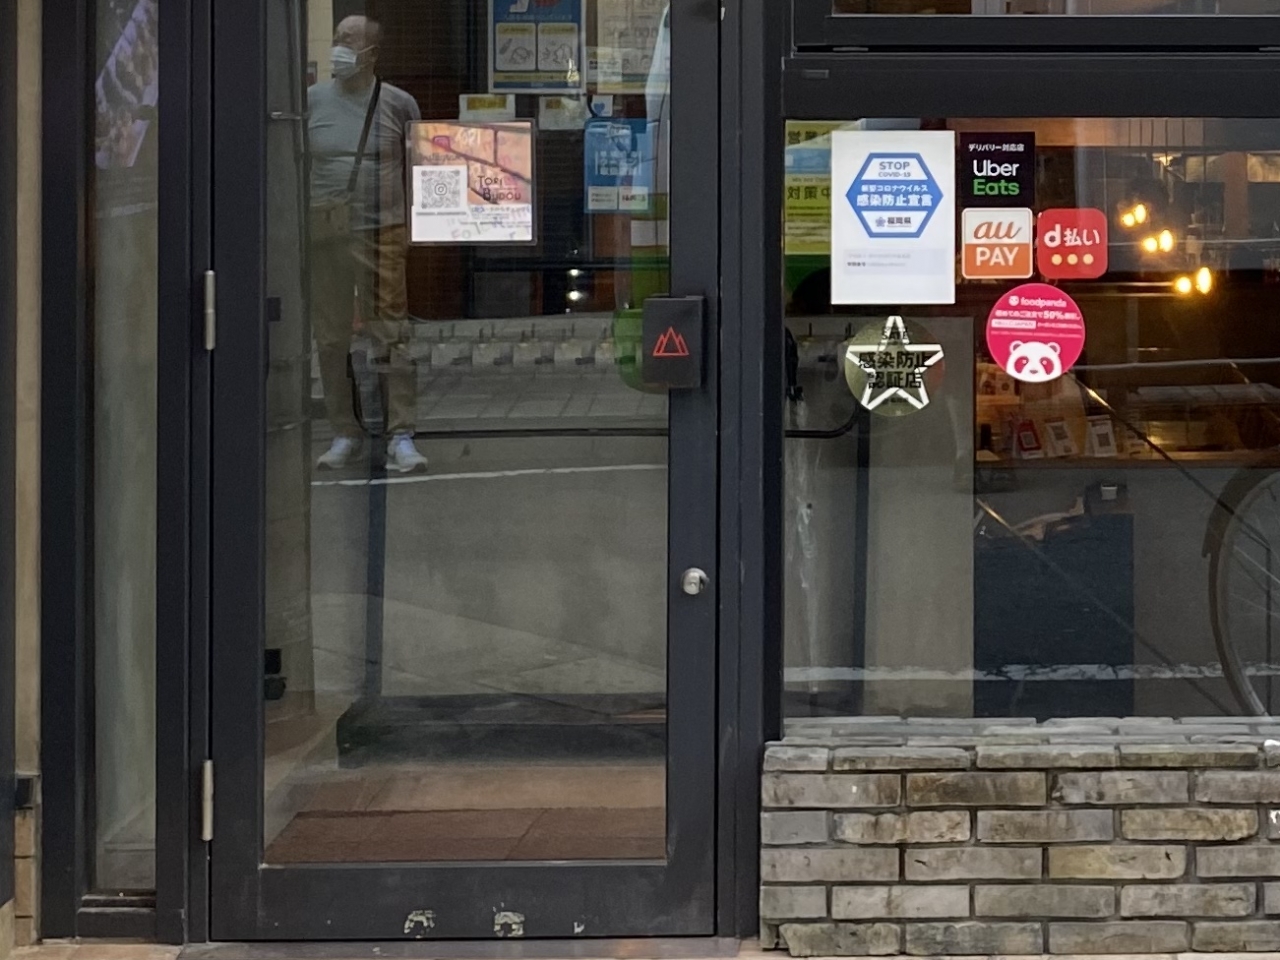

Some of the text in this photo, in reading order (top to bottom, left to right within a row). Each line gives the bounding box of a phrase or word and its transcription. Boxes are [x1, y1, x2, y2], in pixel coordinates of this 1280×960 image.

[879, 161, 911, 171] STOP
[973, 159, 1020, 177] Uber
[973, 179, 1020, 196] Eats
[856, 193, 933, 207] 感染防止宣言
[973, 221, 1023, 240] au
[1044, 223, 1100, 248] d払い
[975, 246, 1019, 267] PAY
[1020, 296, 1067, 308] foodpanda
[858, 351, 932, 369] 感染防止
[867, 371, 922, 389] 認証店
